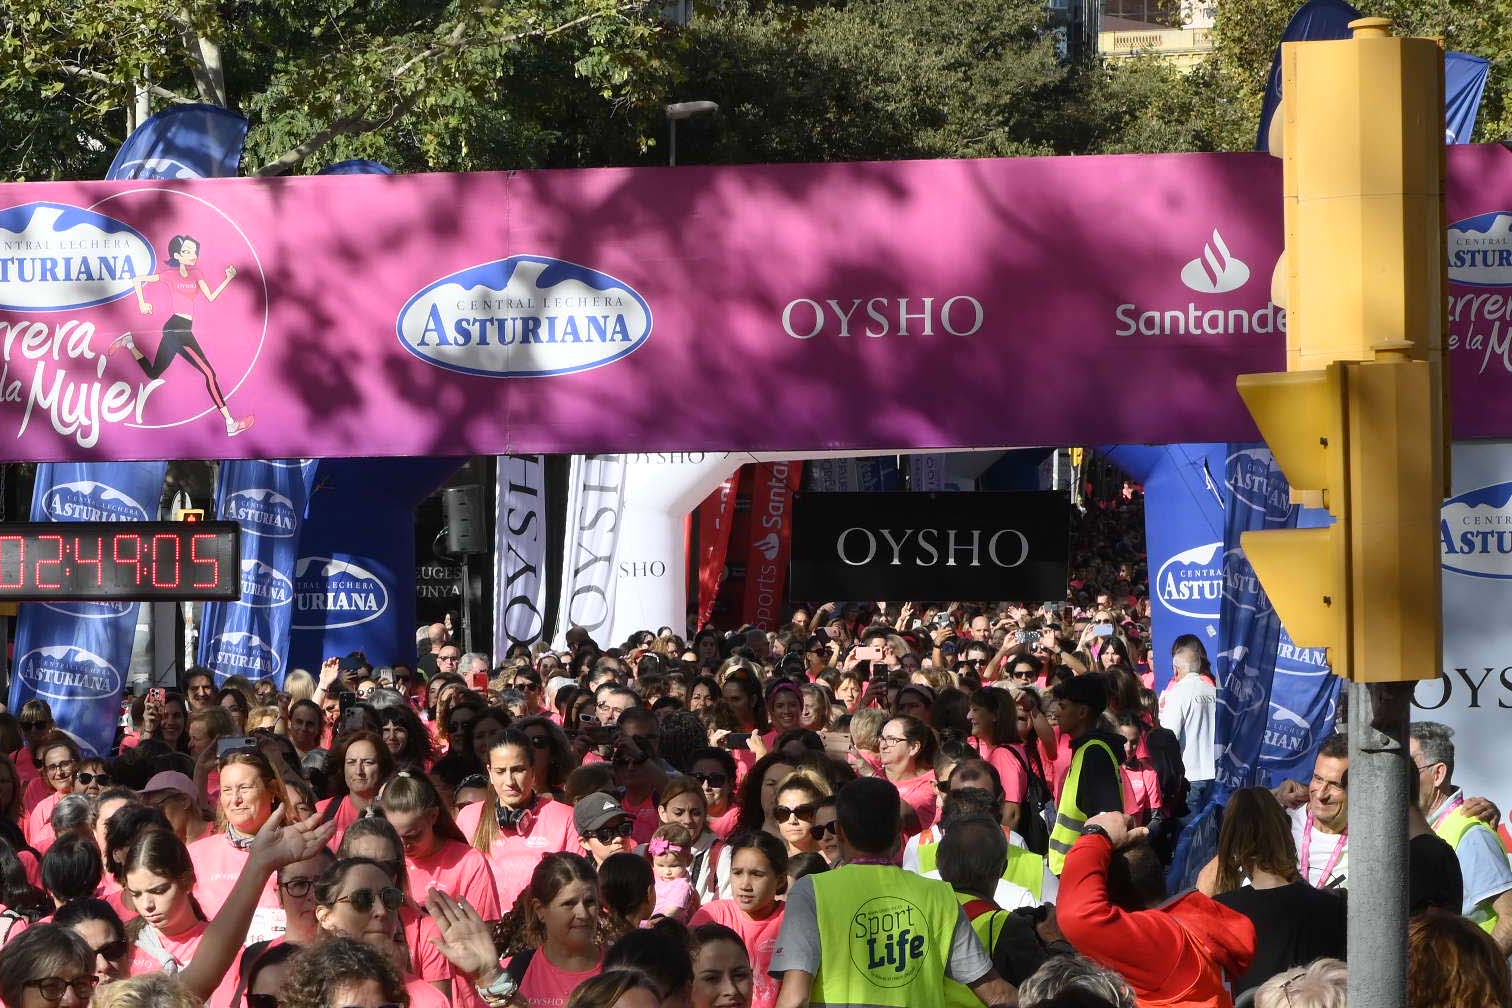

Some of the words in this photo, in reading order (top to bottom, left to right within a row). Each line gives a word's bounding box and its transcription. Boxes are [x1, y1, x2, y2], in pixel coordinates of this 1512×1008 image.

[59, 238, 131, 250] LECHERA
[1448, 250, 1512, 268] STUR
[456, 298, 534, 312] CENTRAL
[543, 296, 624, 309] LECHERA
[782, 295, 985, 340] OYSHO
[417, 302, 633, 348] ASTURIANA
[1115, 303, 1287, 337] Santande
[1465, 323, 1483, 350] la
[16, 354, 166, 449] Mujer
[762, 461, 788, 529] Santa
[228, 501, 293, 530] ASTURIAN
[1462, 515, 1512, 525] CENTR
[569, 455, 621, 633] OYSH
[837, 527, 1029, 568] OYSHO
[1441, 517, 1512, 554] ASTU
[504, 455, 543, 647] OYSH
[619, 560, 666, 578] SHO
[1180, 569, 1222, 578] CENTRA
[328, 581, 374, 590] ECHERA
[1163, 571, 1223, 600] ASTU
[294, 592, 379, 611] URIANA
[216, 650, 272, 671] STURIANA
[24, 662, 111, 691] ASTURIANA
[1409, 665, 1512, 710] OYS
[855, 905, 915, 940] Sport
[867, 929, 925, 973] Life
[528, 997, 564, 1006] OYSHO
